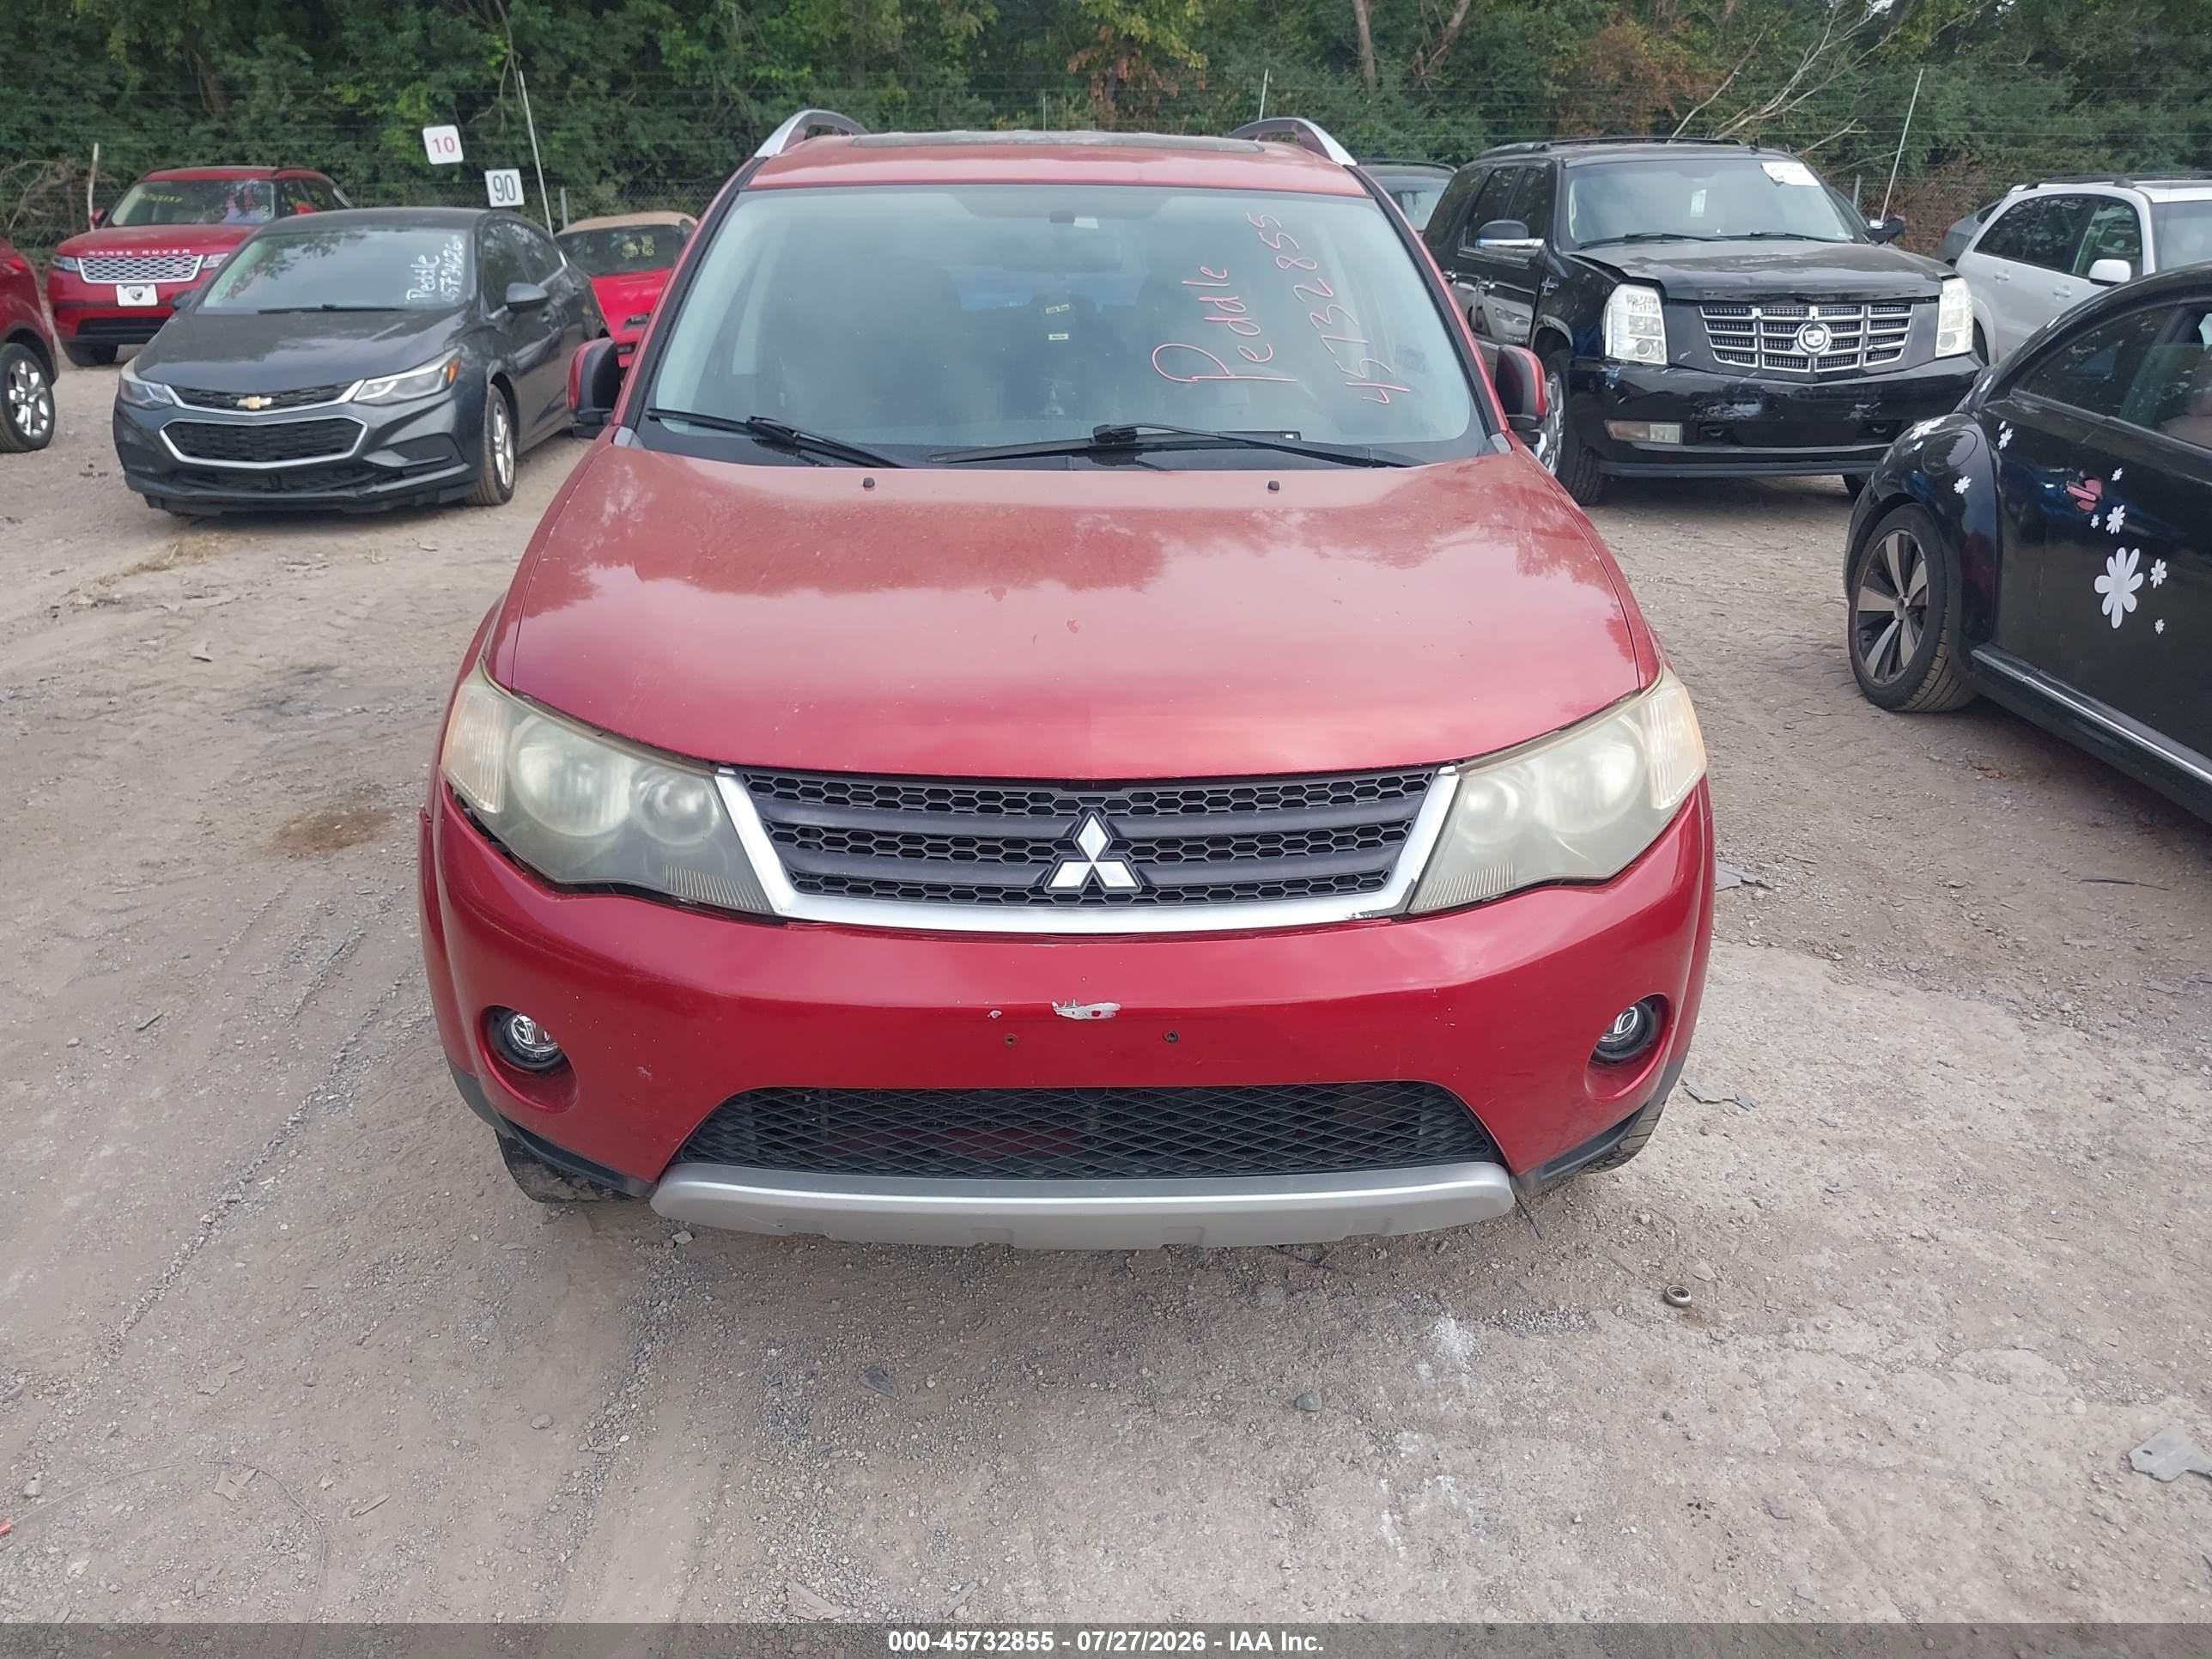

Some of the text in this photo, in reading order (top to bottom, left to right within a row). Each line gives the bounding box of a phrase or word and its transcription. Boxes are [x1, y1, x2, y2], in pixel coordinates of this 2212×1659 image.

[432, 136, 456, 155] 10
[492, 174, 517, 203] 90
[1151, 264, 1298, 383] Peddle
[1245, 212, 1411, 404] 45732855
